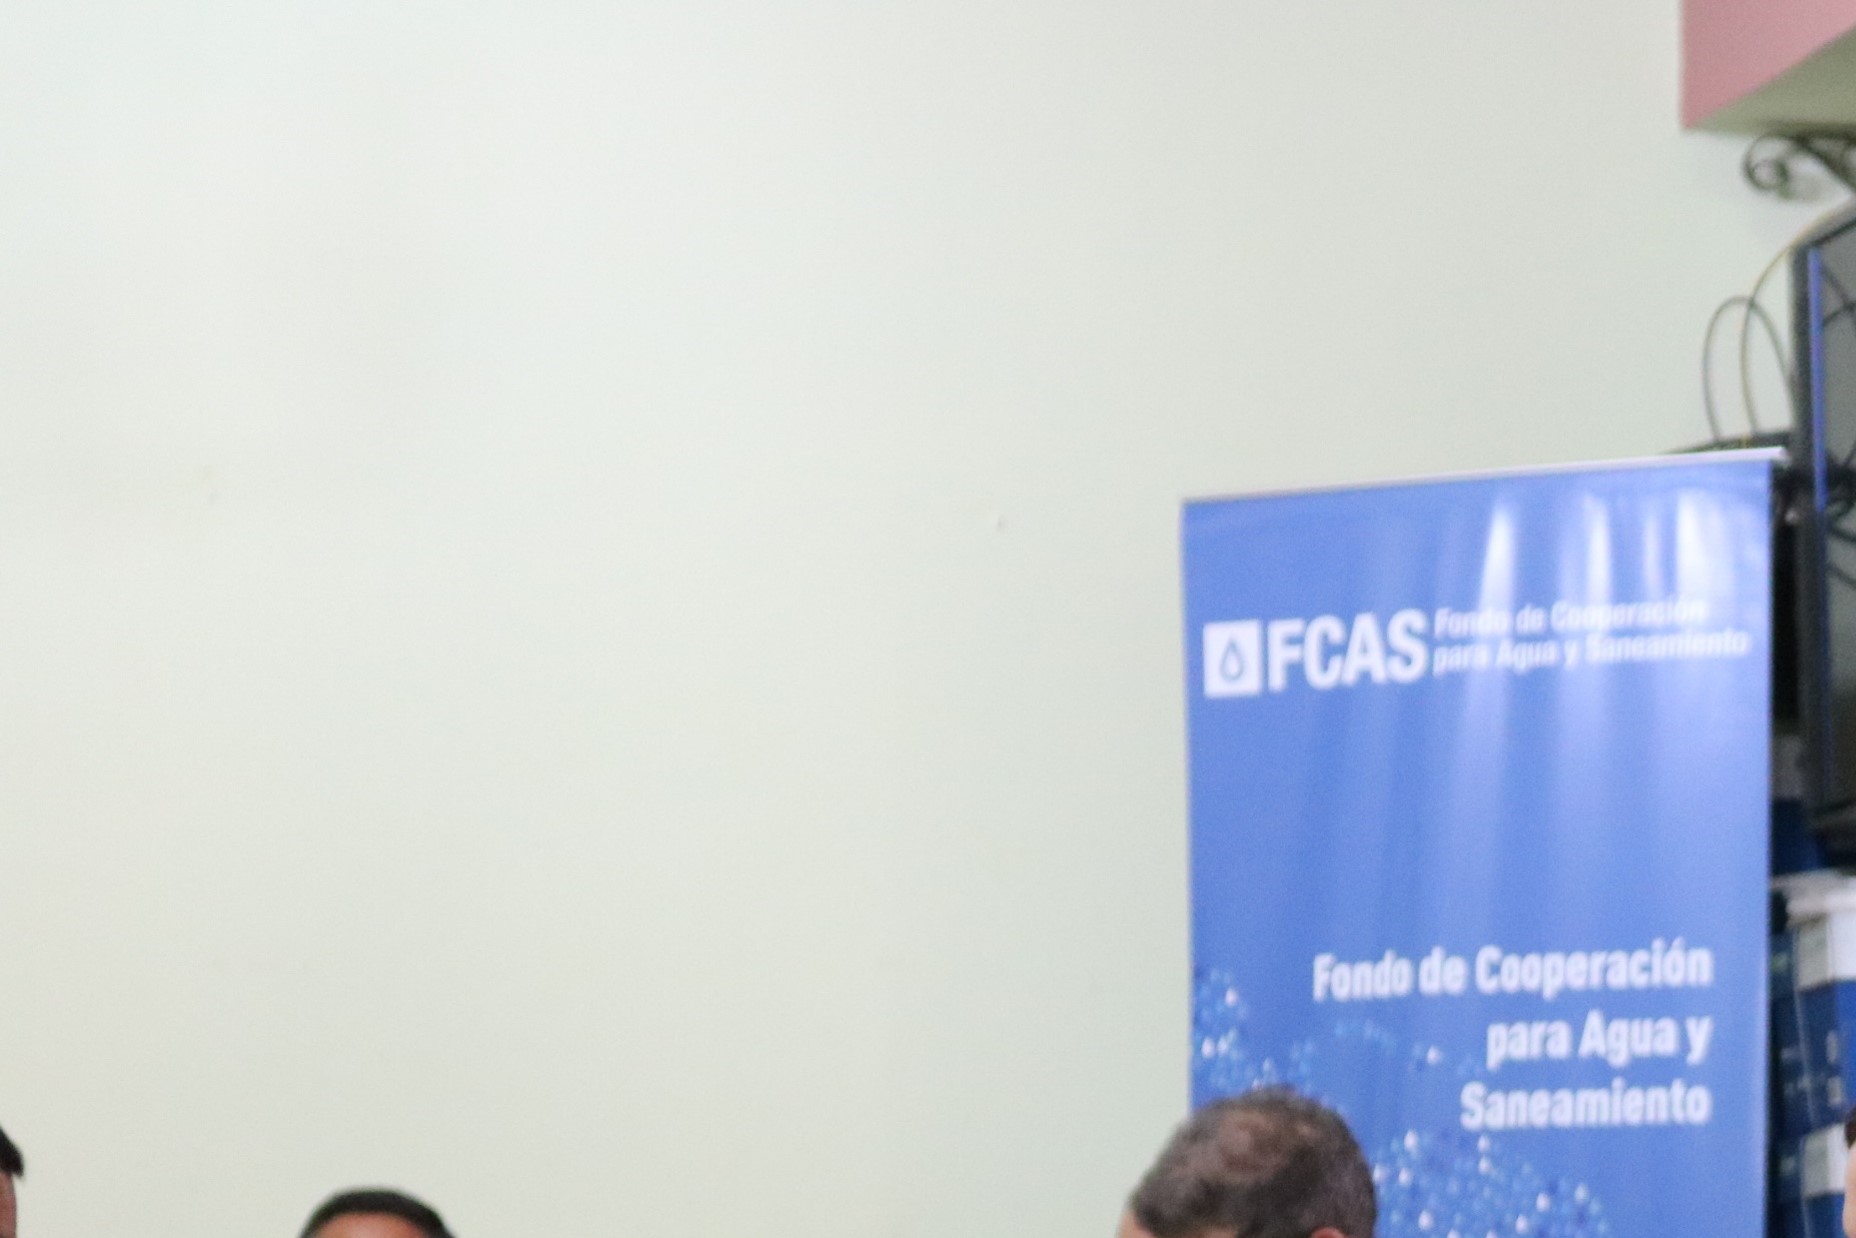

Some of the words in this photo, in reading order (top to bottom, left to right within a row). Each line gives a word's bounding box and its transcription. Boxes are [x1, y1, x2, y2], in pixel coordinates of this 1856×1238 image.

[1267, 607, 1429, 693] FCAS
[1435, 606, 1511, 639] Fondo
[1516, 604, 1547, 634] de
[1433, 643, 1489, 677] para
[1496, 638, 1559, 674] Agua
[1563, 639, 1580, 670] y
[1586, 627, 1749, 662] Saneamiento
[1313, 949, 1414, 1001] Fondo
[1418, 945, 1469, 996] de
[1475, 936, 1714, 1001] Cooperación
[1486, 1019, 1573, 1073] para
[1578, 1008, 1680, 1069] Agua
[1685, 1015, 1713, 1066] y
[1460, 1076, 1714, 1132] Saneamiento
